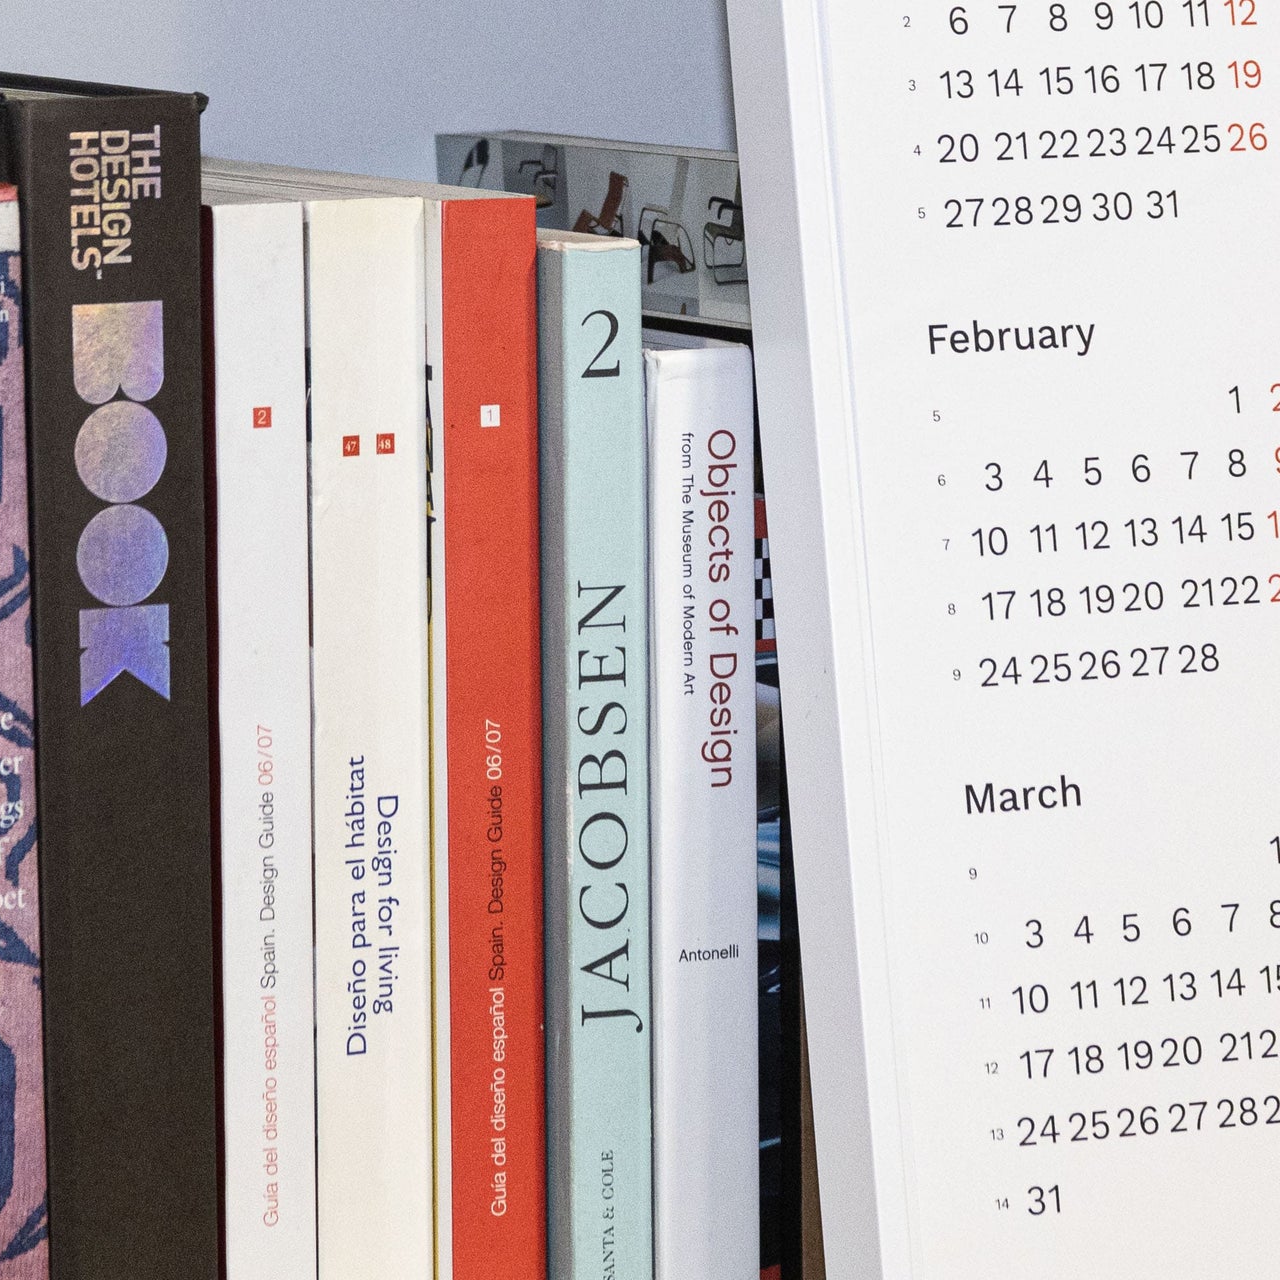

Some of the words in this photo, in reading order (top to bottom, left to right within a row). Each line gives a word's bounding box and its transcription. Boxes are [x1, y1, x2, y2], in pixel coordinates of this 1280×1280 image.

[131, 125, 161, 199] THE
[101, 130, 132, 264] DESIGN
[581, 310, 620, 378] 2
[929, 320, 1094, 356] February
[257, 411, 266, 424] 2
[682, 432, 694, 468] from
[71, 300, 170, 706] BOOK
[682, 474, 694, 502] The
[700, 430, 737, 583] Objects
[682, 510, 694, 578] Museum
[683, 584, 695, 599] of
[709, 599, 738, 635] of
[683, 606, 695, 666] Modern
[684, 673, 695, 695] Art
[485, 719, 502, 780] 06/07
[701, 653, 738, 787] Design
[257, 724, 273, 786] 06/07
[258, 792, 274, 849] Guide
[345, 755, 365, 848] hábitat
[487, 785, 503, 843] Guide
[578, 581, 643, 1033] JACOBSEN
[965, 775, 1081, 814] March
[345, 859, 365, 880] el
[371, 795, 398, 886] Design
[259, 856, 278, 921] Design
[487, 849, 507, 914] Design
[352, 890, 372, 949] para
[378, 896, 399, 935] for
[260, 929, 279, 989] Spain.
[373, 947, 399, 1014] living
[488, 922, 507, 981] Spain.
[679, 944, 739, 962] Antonelli
[261, 996, 279, 1071] español
[347, 960, 366, 1056] Diseño
[489, 987, 508, 1062] español
[262, 1077, 278, 1141] diseño
[490, 1068, 506, 1131] diseño
[263, 1147, 278, 1176] del
[491, 1137, 506, 1166] del
[601, 1150, 614, 1200] COLE
[263, 1182, 279, 1227] Guía
[491, 1171, 507, 1216] Guía
[603, 1206, 614, 1220] &
